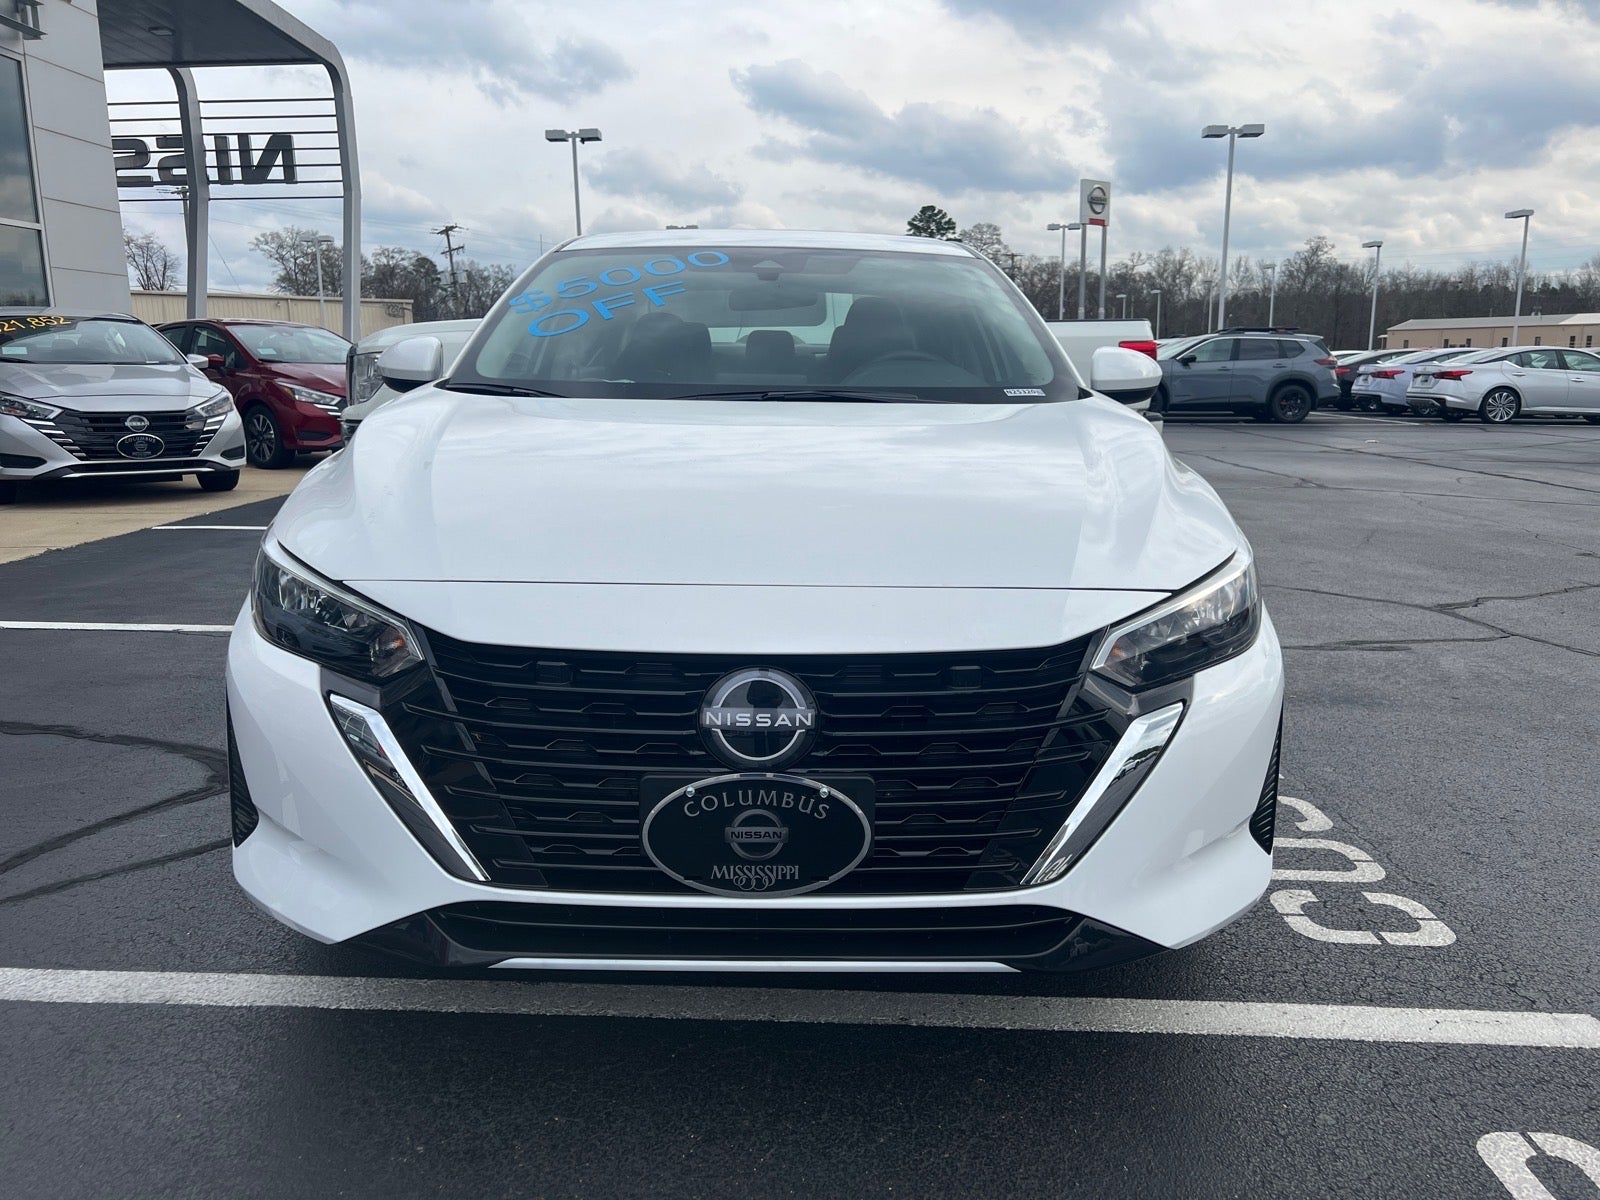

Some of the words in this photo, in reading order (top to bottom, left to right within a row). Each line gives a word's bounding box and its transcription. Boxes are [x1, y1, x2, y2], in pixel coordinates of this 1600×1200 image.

[509, 250, 730, 314] $5000
[528, 280, 687, 337] OFF
[0, 315, 72, 332] 21,852
[705, 711, 813, 728] NISSAN
[684, 790, 831, 820] COLUMBUS
[730, 831, 784, 840] NISSAN
[711, 864, 800, 891] MISSISSIPPI
